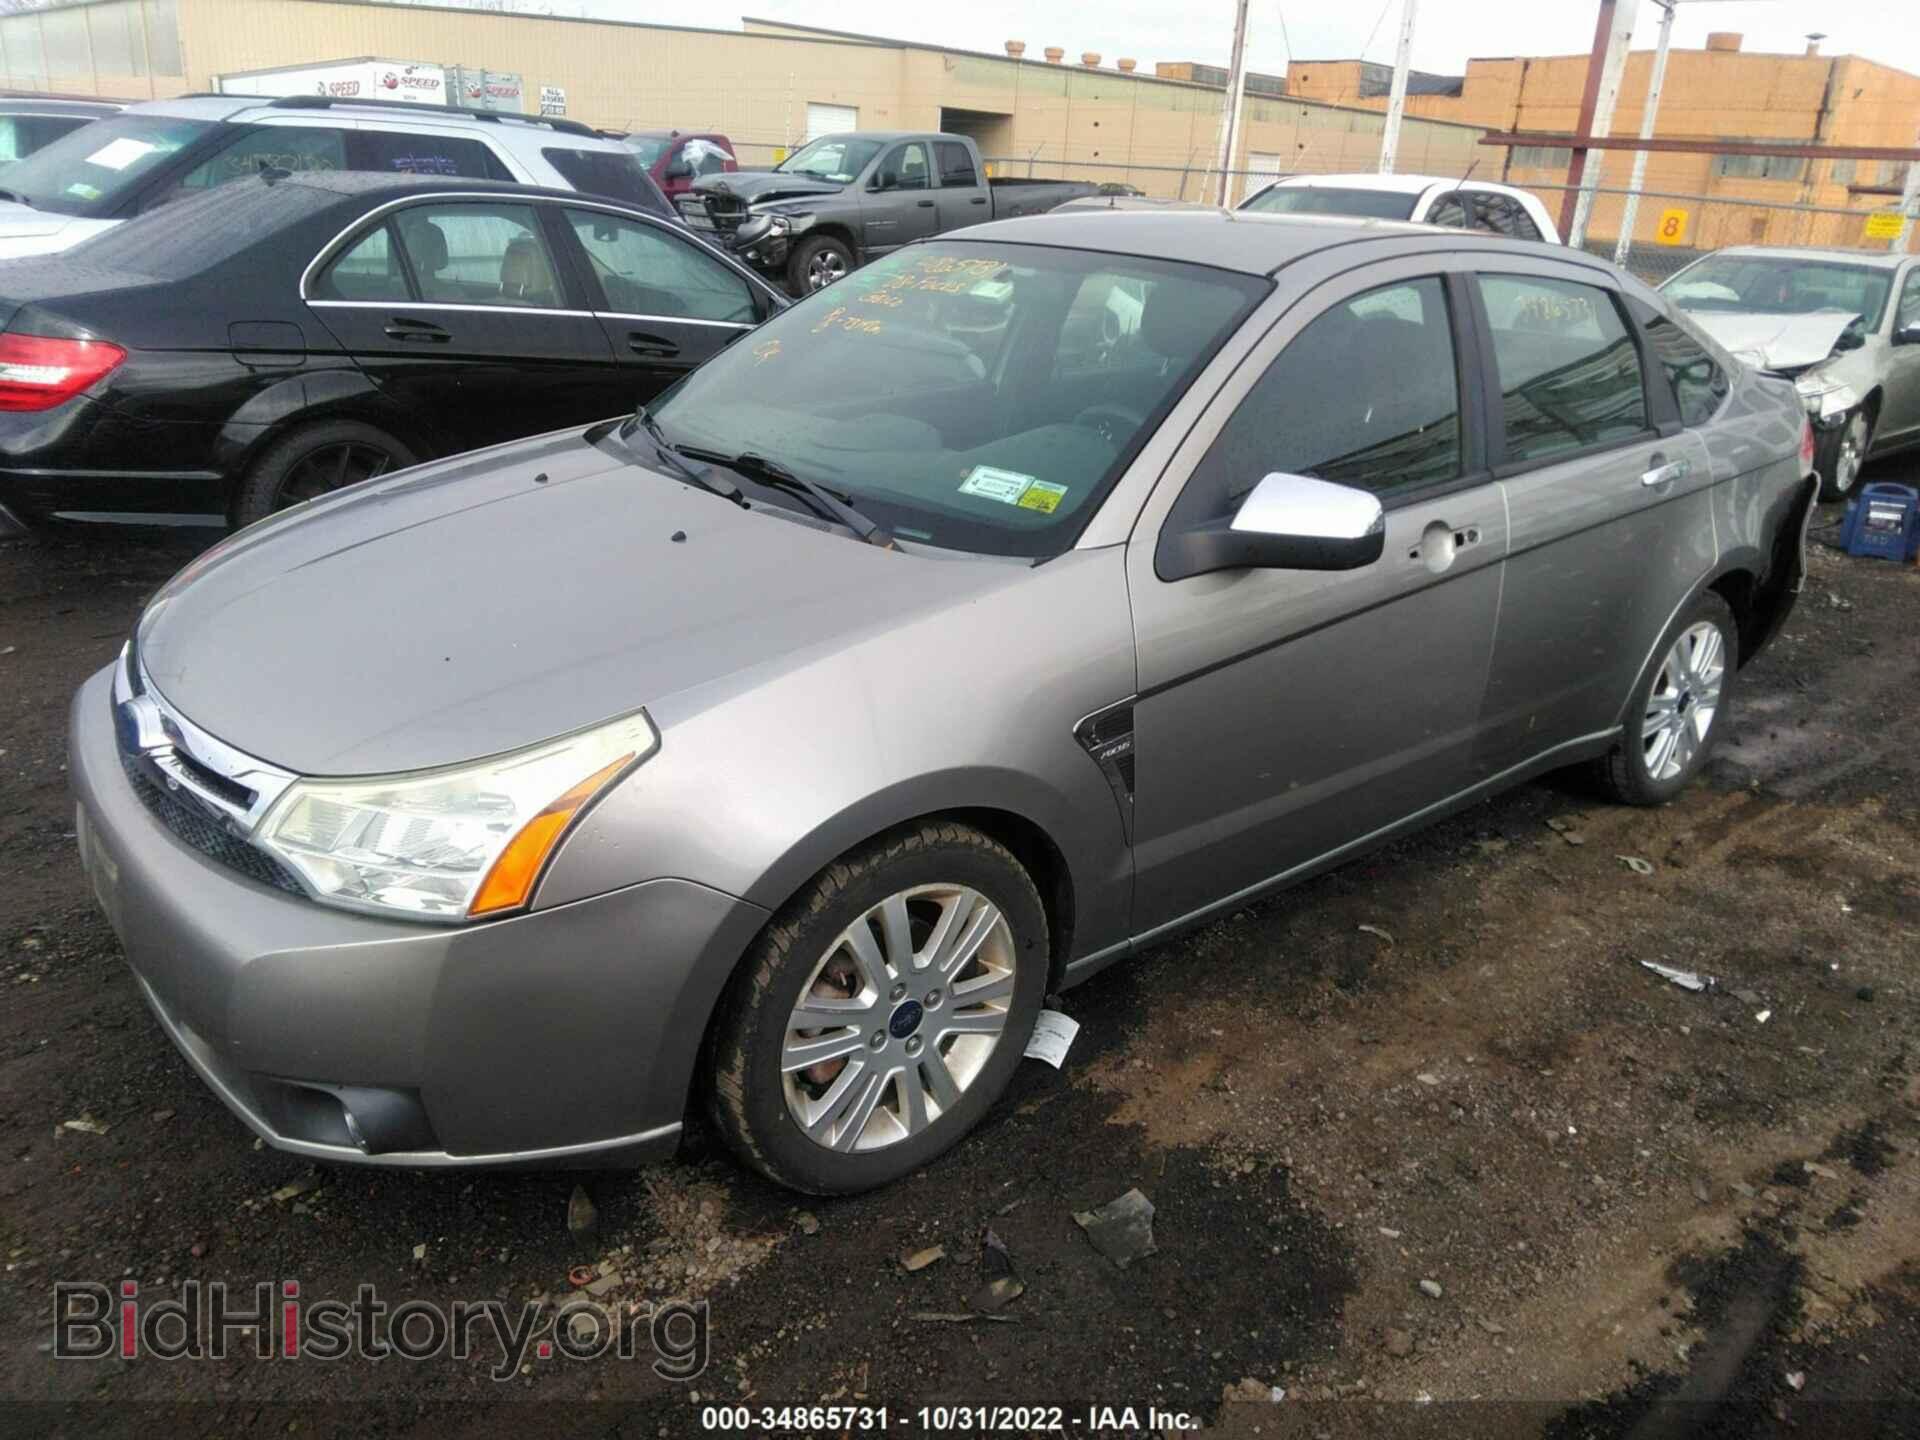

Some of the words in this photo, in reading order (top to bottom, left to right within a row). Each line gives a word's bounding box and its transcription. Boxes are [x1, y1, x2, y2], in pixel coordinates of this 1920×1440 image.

[328, 80, 360, 97] SPEED
[399, 75, 440, 89] SPEED
[1663, 216, 1680, 237] 8
